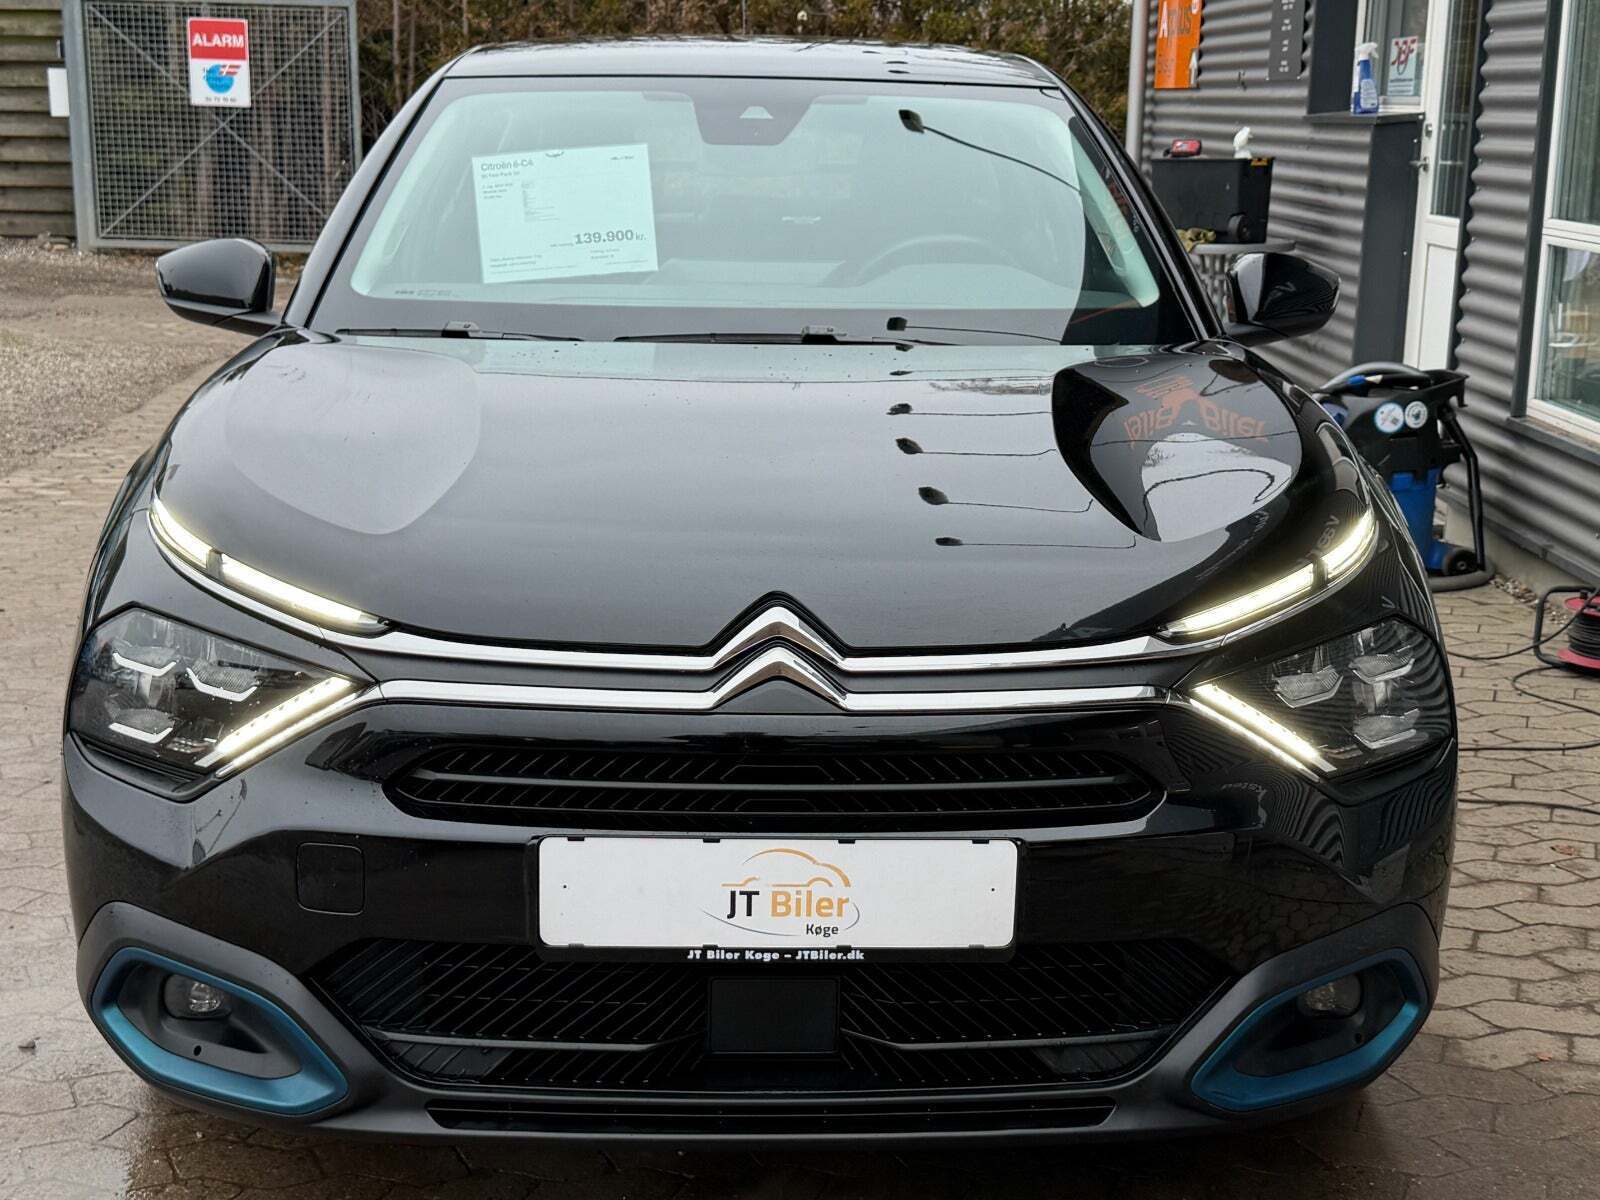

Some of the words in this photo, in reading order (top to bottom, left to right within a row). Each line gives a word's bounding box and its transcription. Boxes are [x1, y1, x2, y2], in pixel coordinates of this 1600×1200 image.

[192, 32, 244, 48] ALARM
[574, 229, 634, 245] 139.900
[635, 231, 647, 241] kr.
[727, 890, 760, 919] JT
[771, 890, 849, 918] Biler
[805, 924, 839, 937] Køge
[687, 949, 702, 960] JT
[706, 949, 741, 960] Biler
[795, 949, 865, 960] JTBiler.dk
